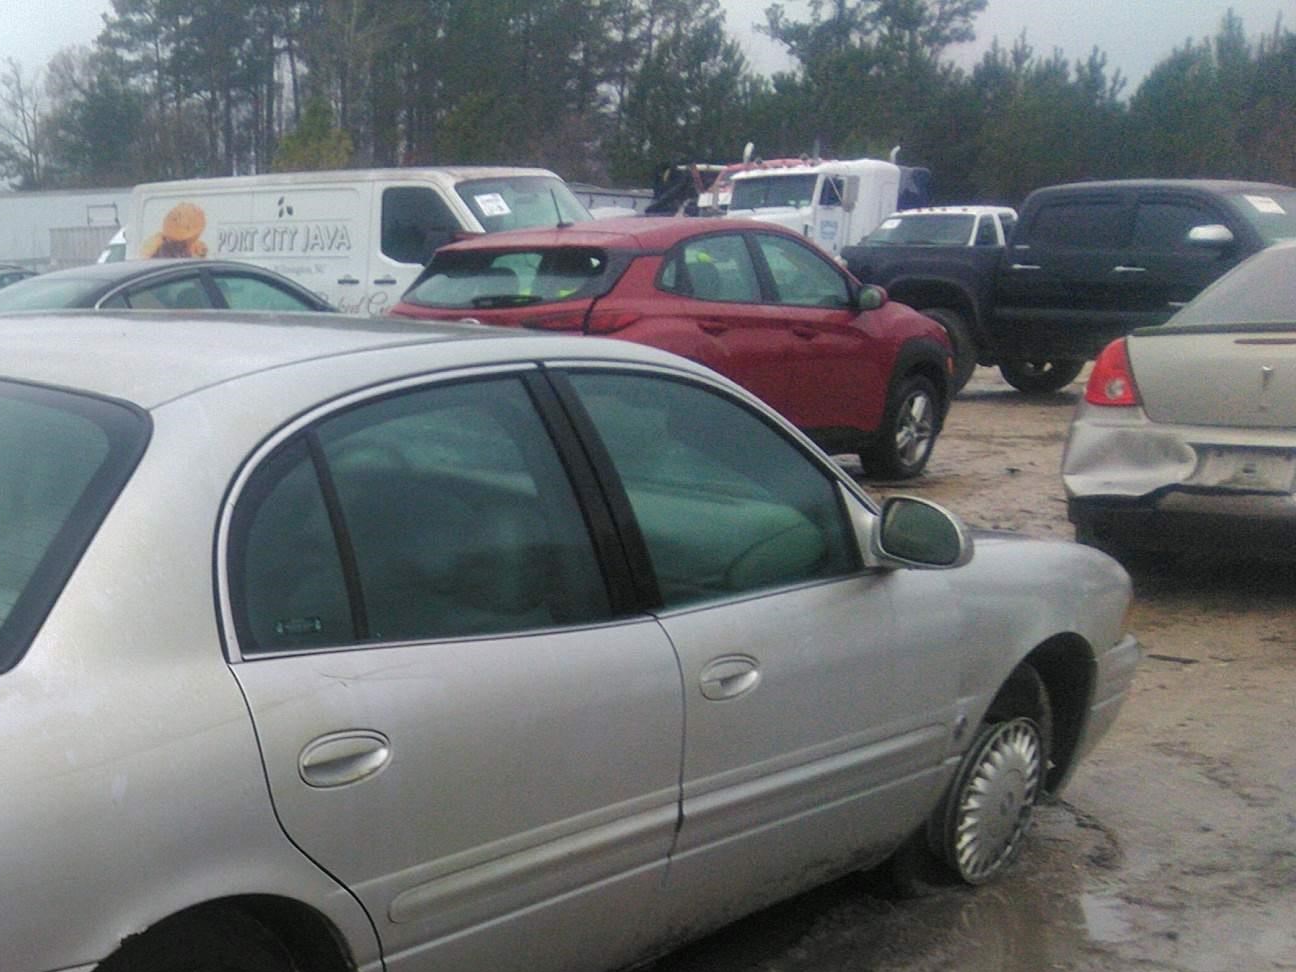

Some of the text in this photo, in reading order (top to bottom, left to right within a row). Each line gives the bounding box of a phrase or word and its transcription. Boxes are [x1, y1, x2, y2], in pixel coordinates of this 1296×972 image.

[217, 224, 352, 253] PORT CITY JAVA
